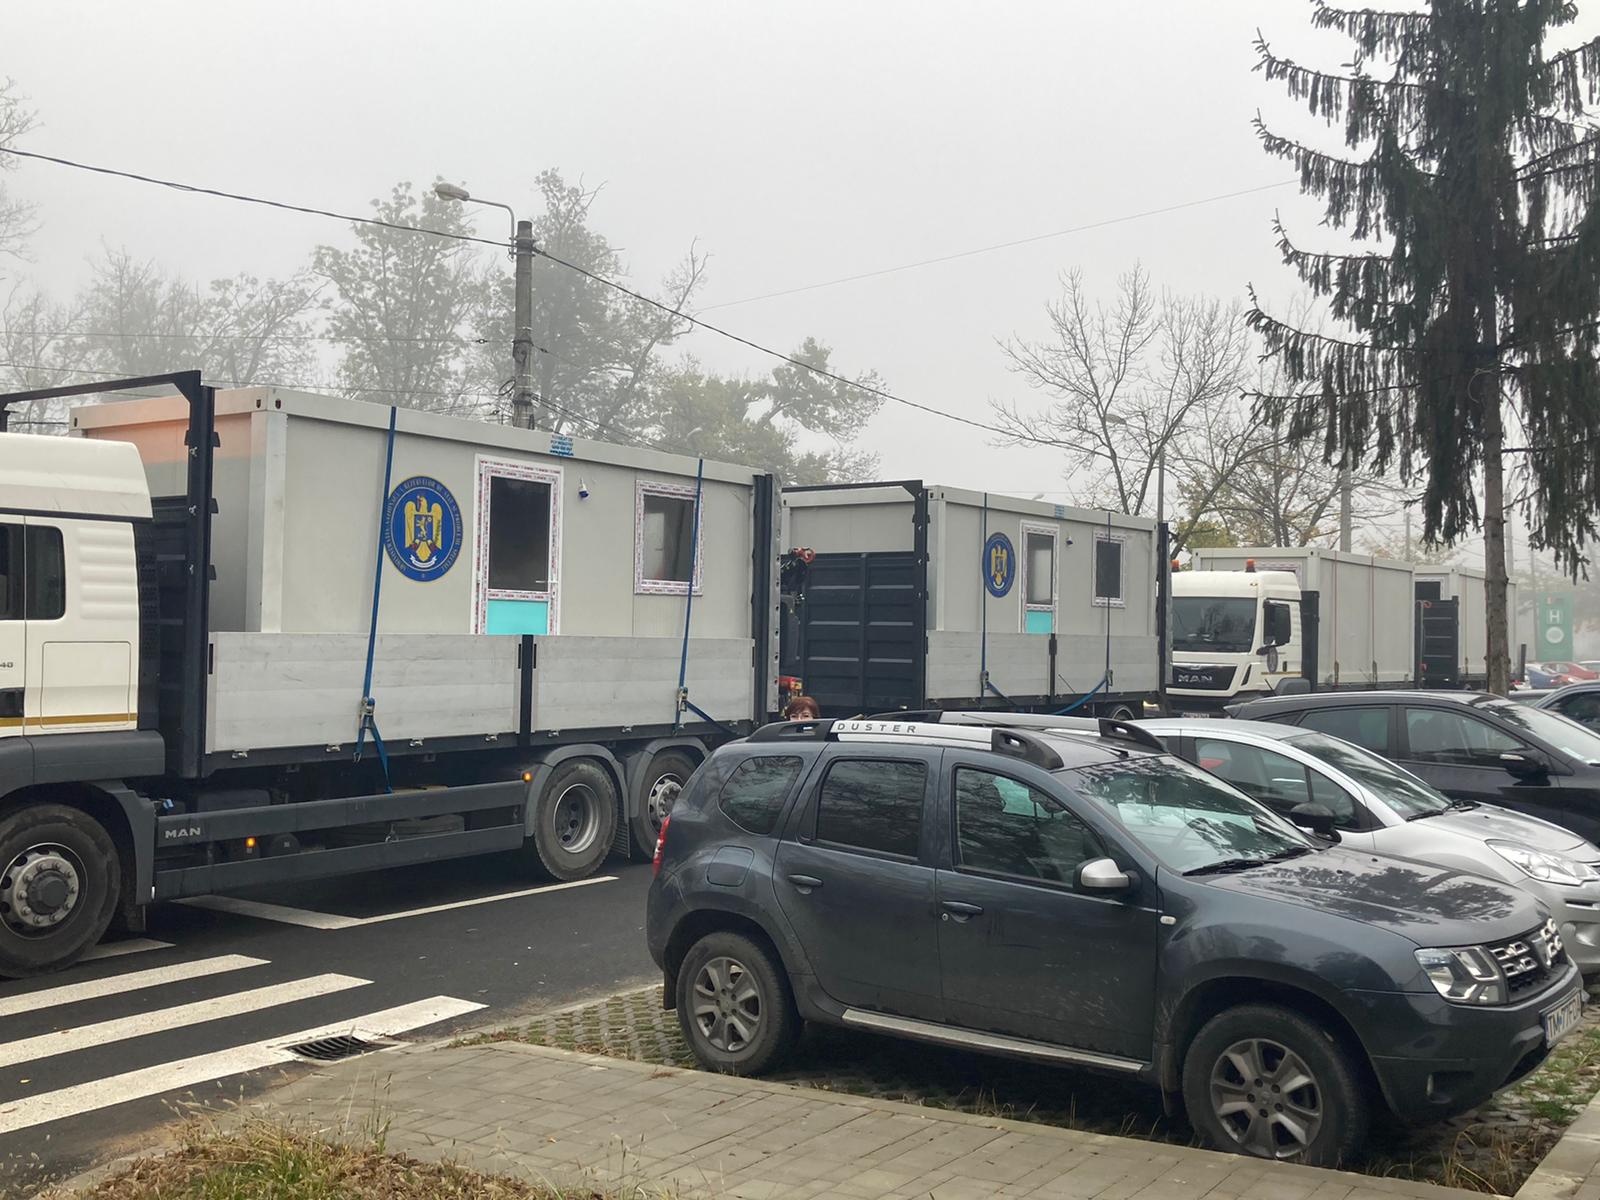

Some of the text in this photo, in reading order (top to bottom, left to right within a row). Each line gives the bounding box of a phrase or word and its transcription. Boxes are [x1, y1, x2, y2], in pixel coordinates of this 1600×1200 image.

[1549, 609, 1560, 624] H
[1178, 674, 1213, 683] MAN
[837, 722, 917, 734] DUSTER
[164, 827, 201, 839] MAN
